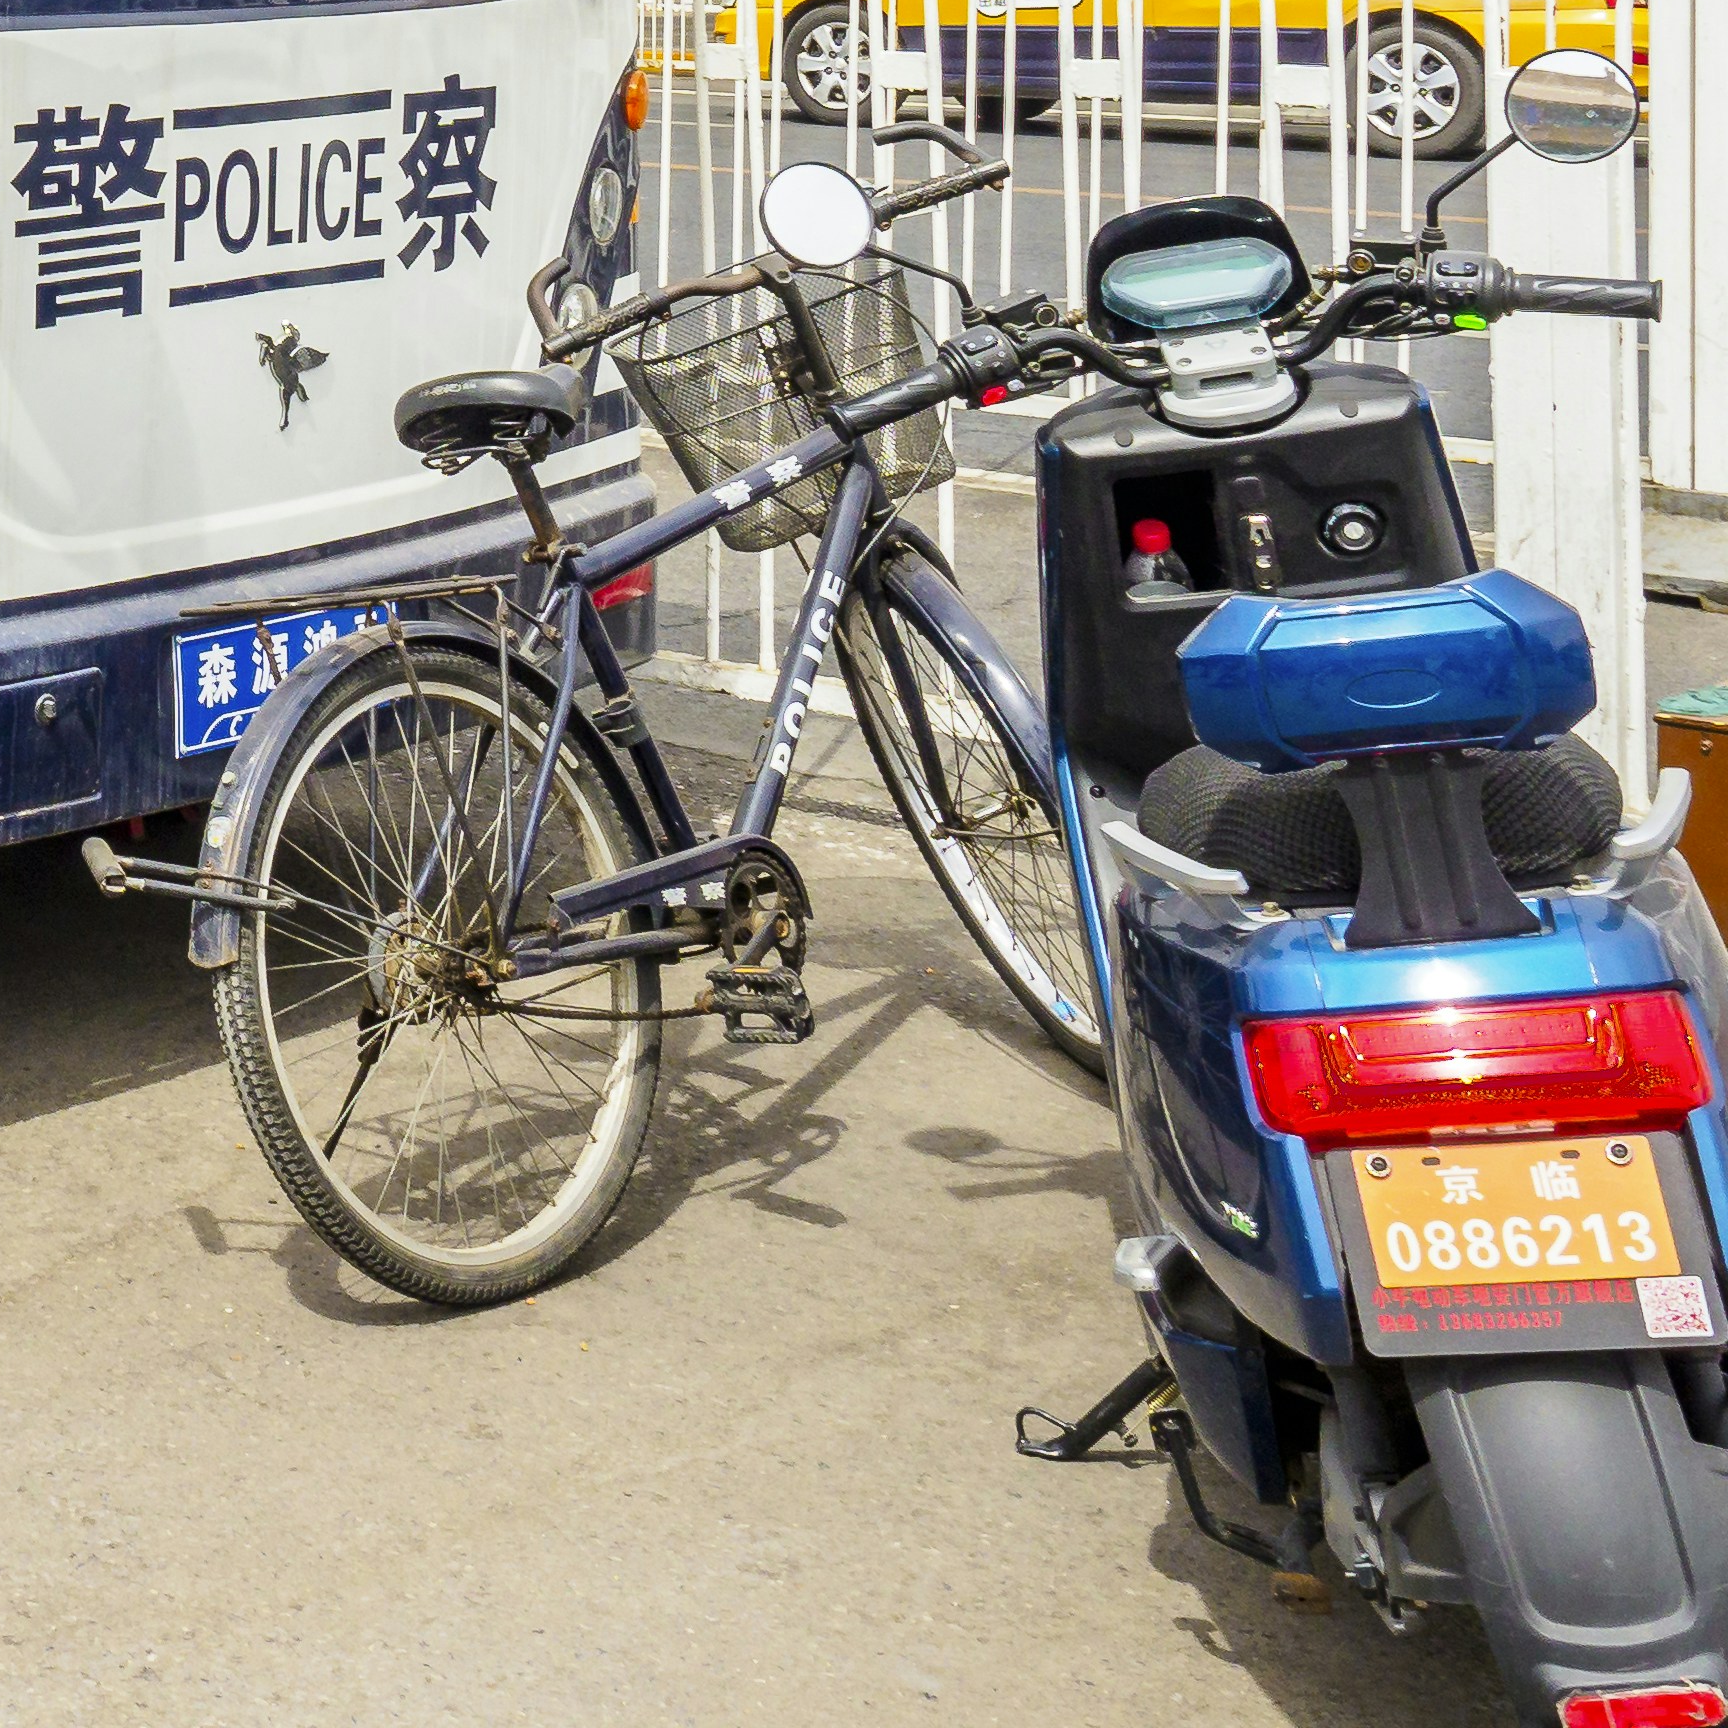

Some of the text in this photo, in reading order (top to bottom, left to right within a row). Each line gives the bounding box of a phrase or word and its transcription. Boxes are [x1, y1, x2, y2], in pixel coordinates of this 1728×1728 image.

[10, 73, 498, 329] 警 POLICE 察
[770, 569, 847, 777] POLICE
[1386, 1210, 1657, 1273] 0886213
